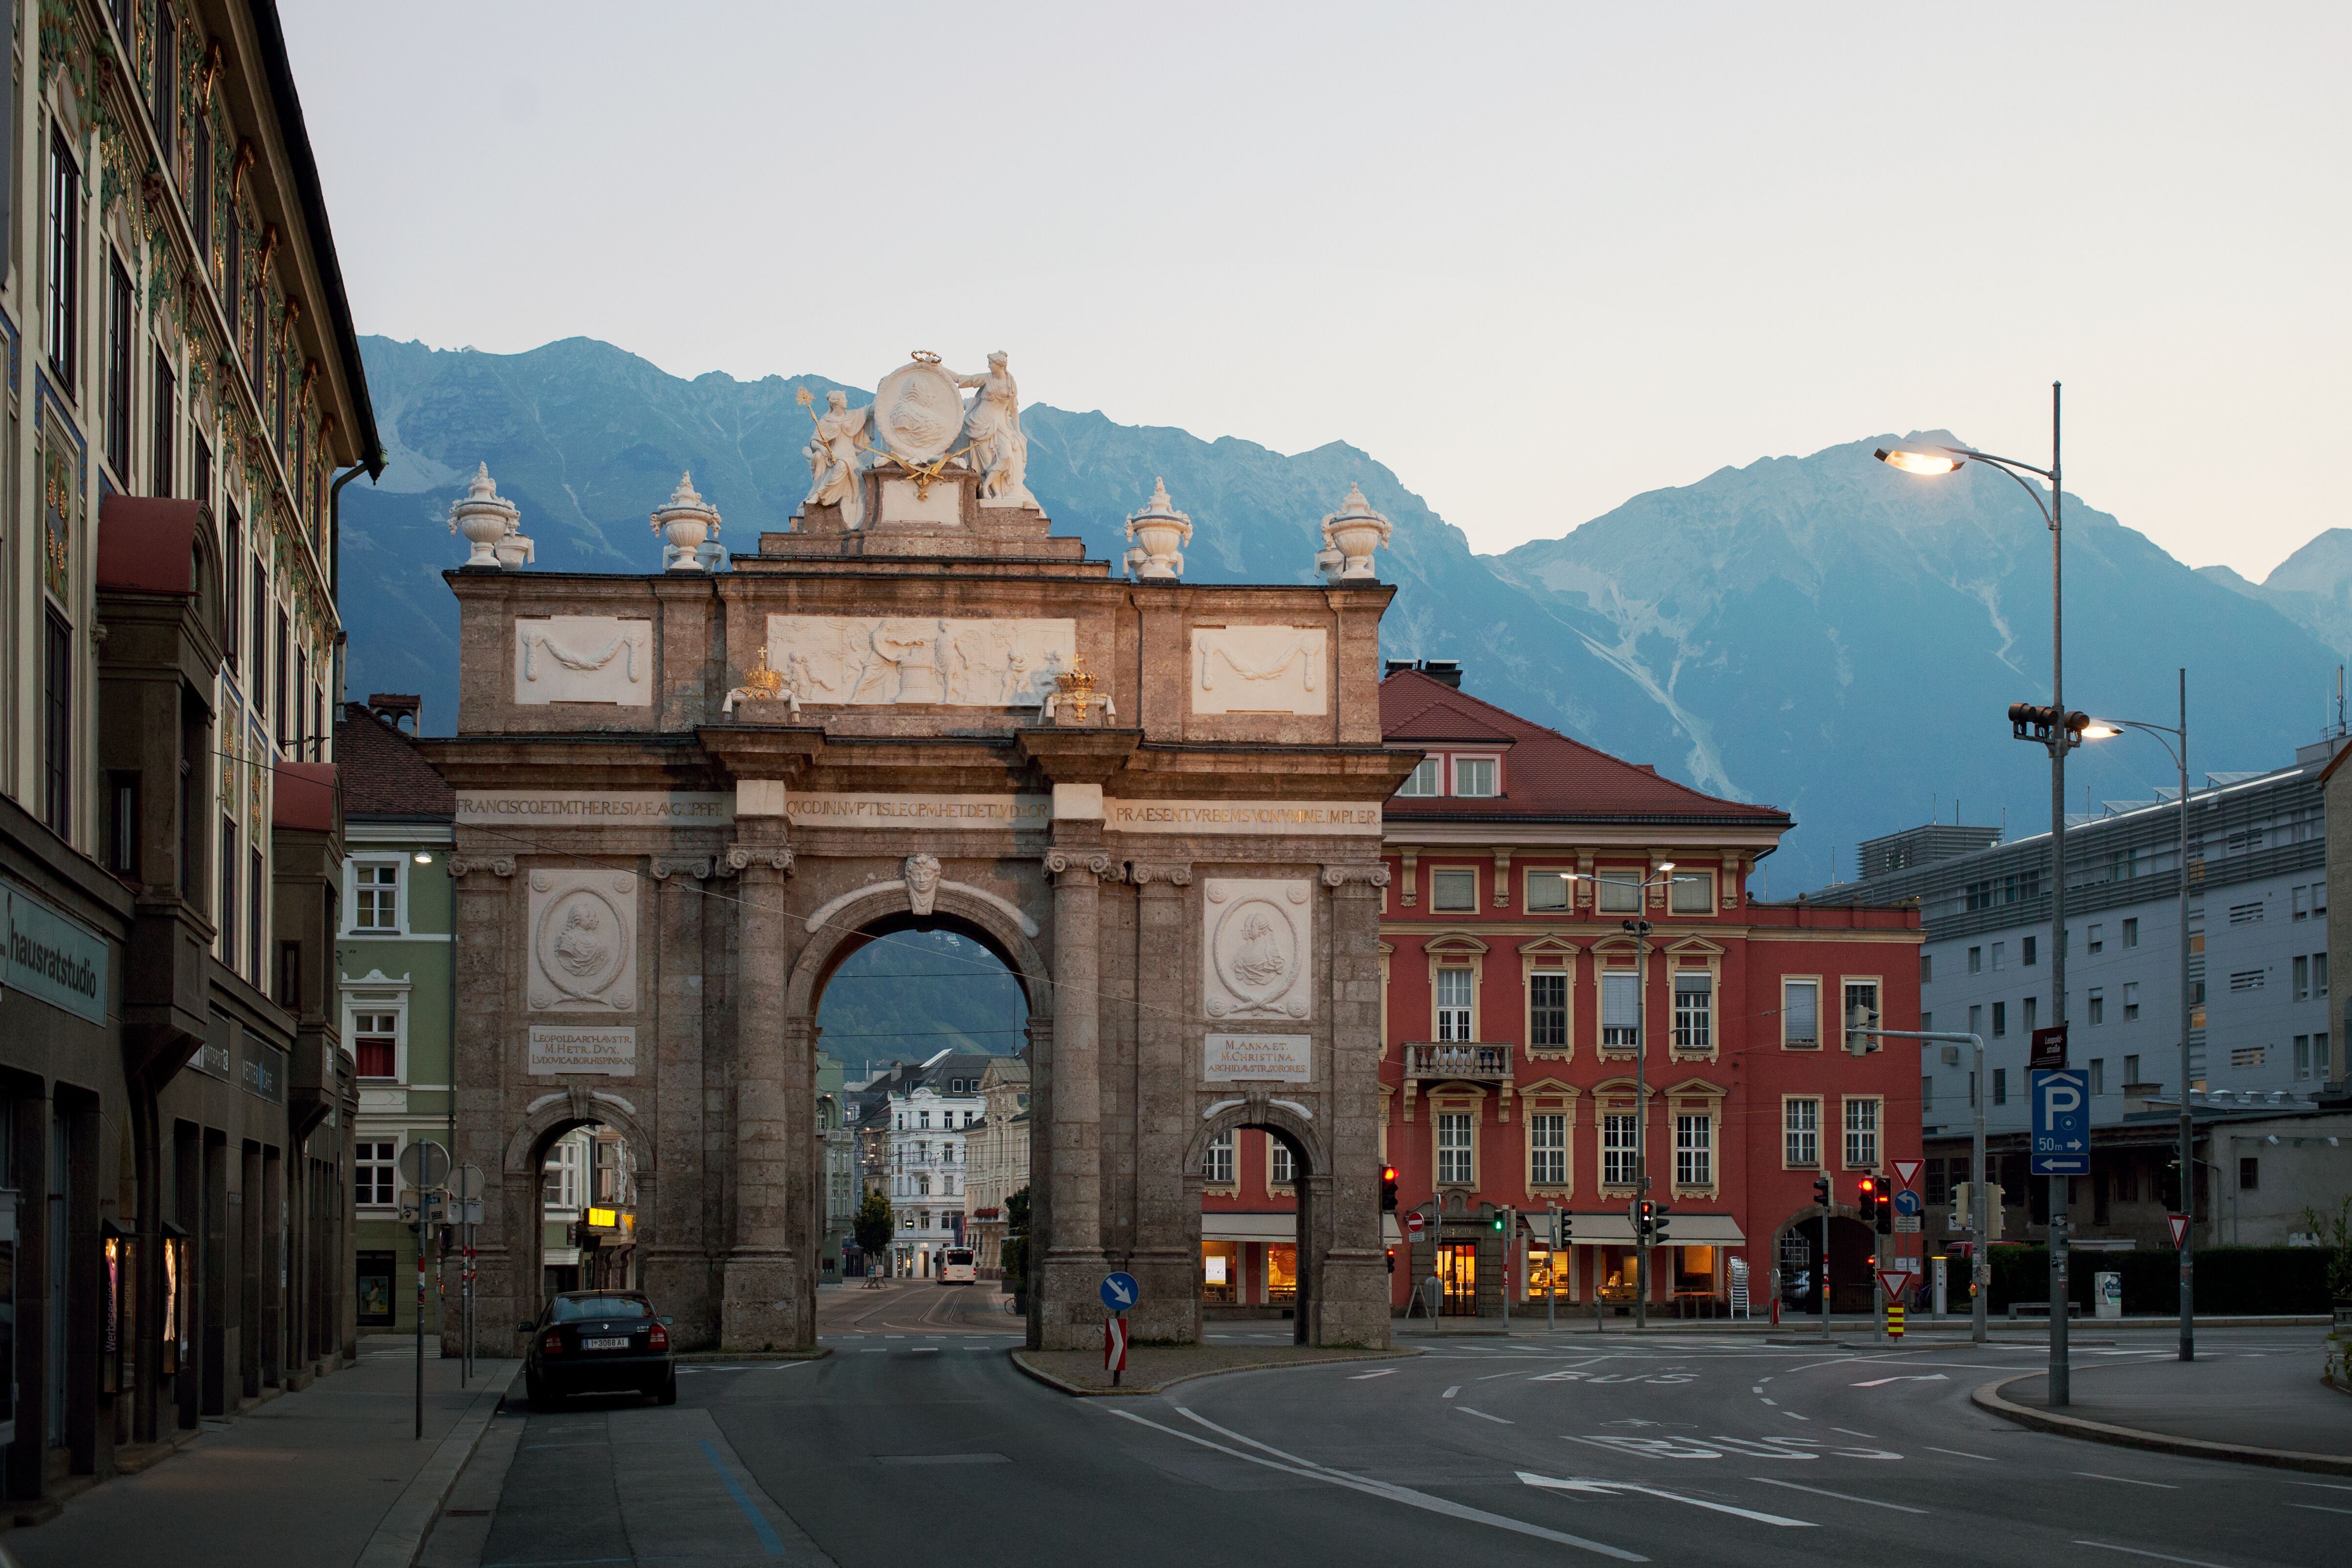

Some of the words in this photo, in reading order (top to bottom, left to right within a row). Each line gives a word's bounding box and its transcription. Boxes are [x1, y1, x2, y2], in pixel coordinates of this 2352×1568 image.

[10, 918, 96, 998] hausratstudio
[2045, 1034, 2063, 1045] Leopold-
[2046, 1044, 2060, 1054] straße
[243, 1058, 258, 1084] WETTER
[2045, 1086, 2081, 1130] P
[105, 1281, 116, 1352] Werbeservice
[1528, 1370, 1701, 1384] BUS
[1581, 1436, 1905, 1459] BUS
